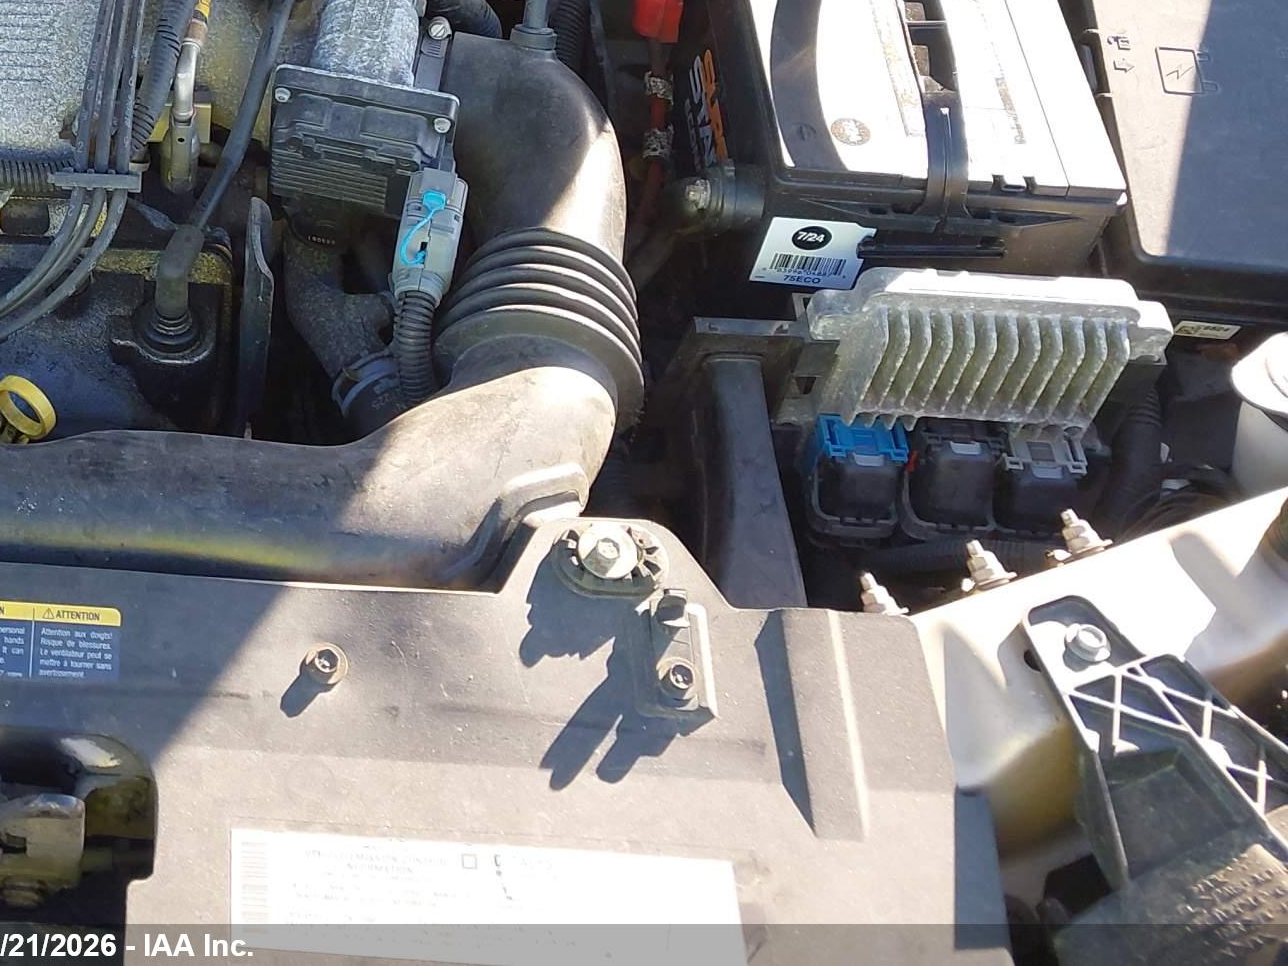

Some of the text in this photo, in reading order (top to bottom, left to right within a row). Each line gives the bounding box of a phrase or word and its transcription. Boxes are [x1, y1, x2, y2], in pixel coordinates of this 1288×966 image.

[797, 231, 825, 243] 7/24
[783, 274, 821, 284] 75ECO
[56, 609, 100, 621] ATTENTION
[40, 627, 71, 636] Attention
[4, 636, 25, 645] hands
[40, 637, 63, 647] Risque
[66, 640, 75, 648] de
[39, 648, 48, 656] Le
[50, 649, 85, 658] ventilateur
[87, 652, 102, 660] peut
[39, 659, 61, 667] mettre
[70, 660, 93, 669] tourner
[96, 662, 112, 670] sans
